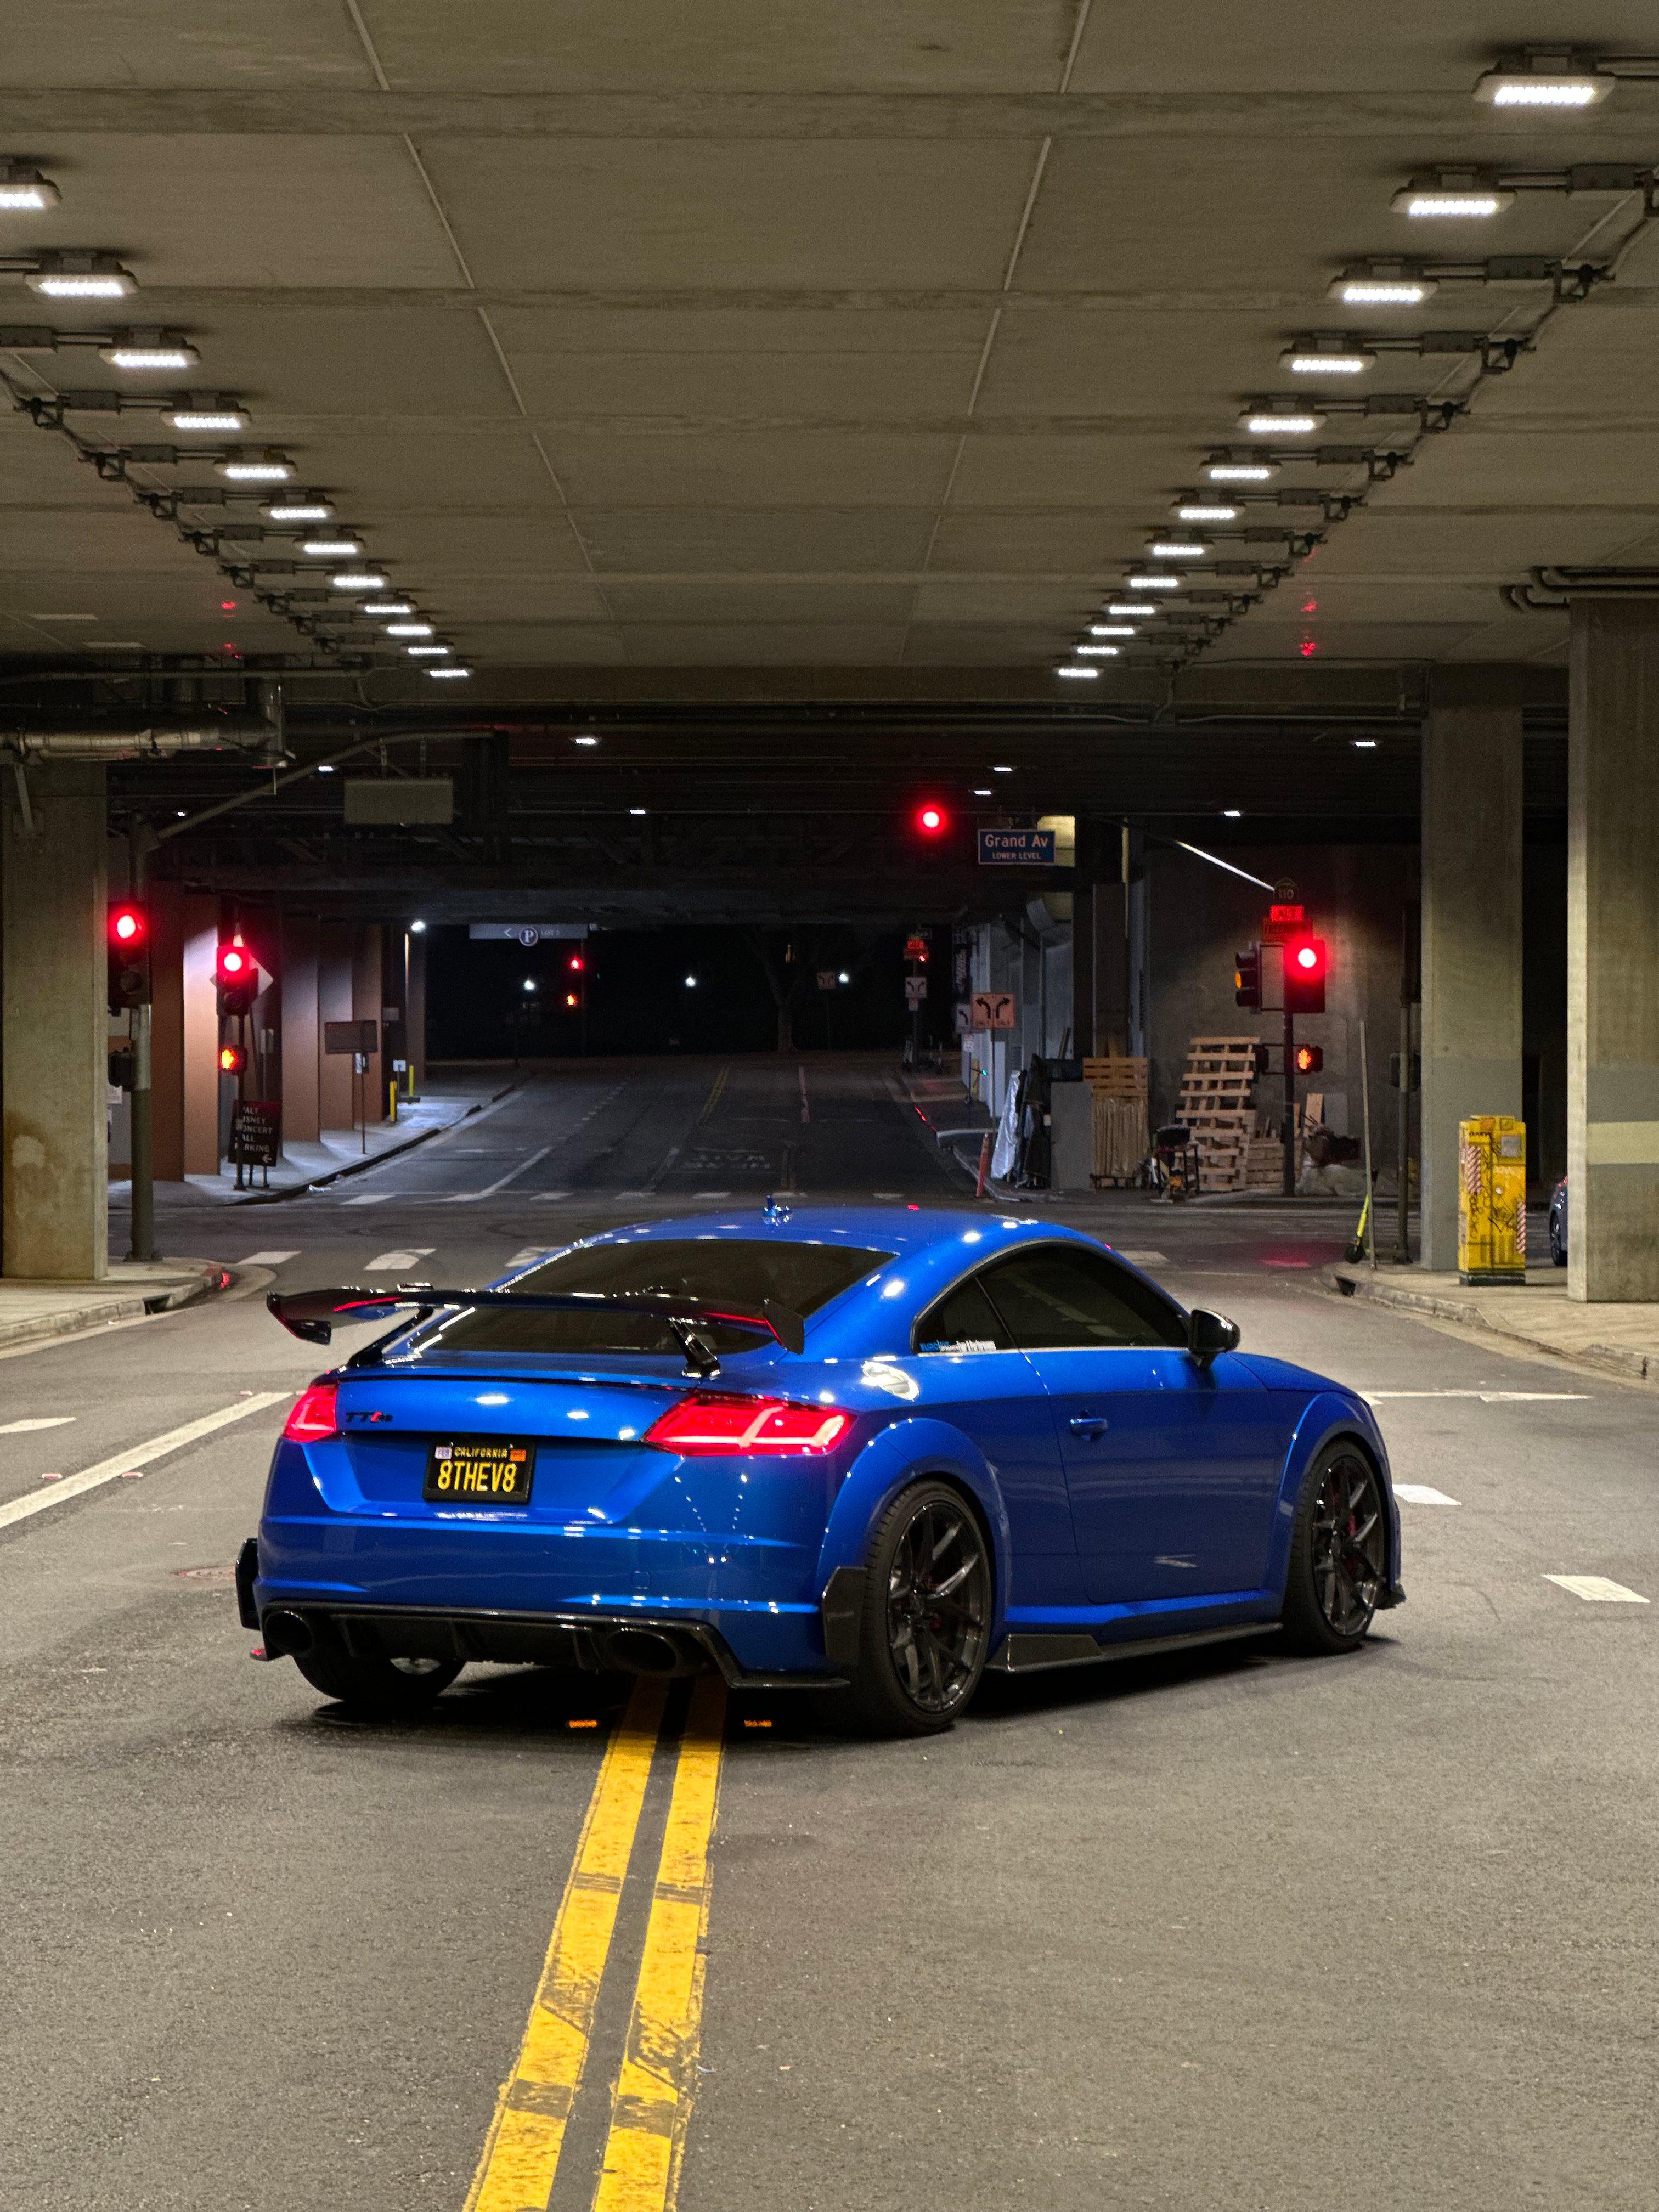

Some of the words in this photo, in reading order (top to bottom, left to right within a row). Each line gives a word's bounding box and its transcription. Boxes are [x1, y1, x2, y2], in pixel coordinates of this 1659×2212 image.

[985, 834, 1026, 848] Grand
[1032, 834, 1048, 848] Av
[243, 1115, 266, 1124] ISNEY
[242, 1125, 273, 1134] ONCERT
[454, 1446, 508, 1458] CALIFORNIA
[437, 1460, 517, 1492] 8THEV8
